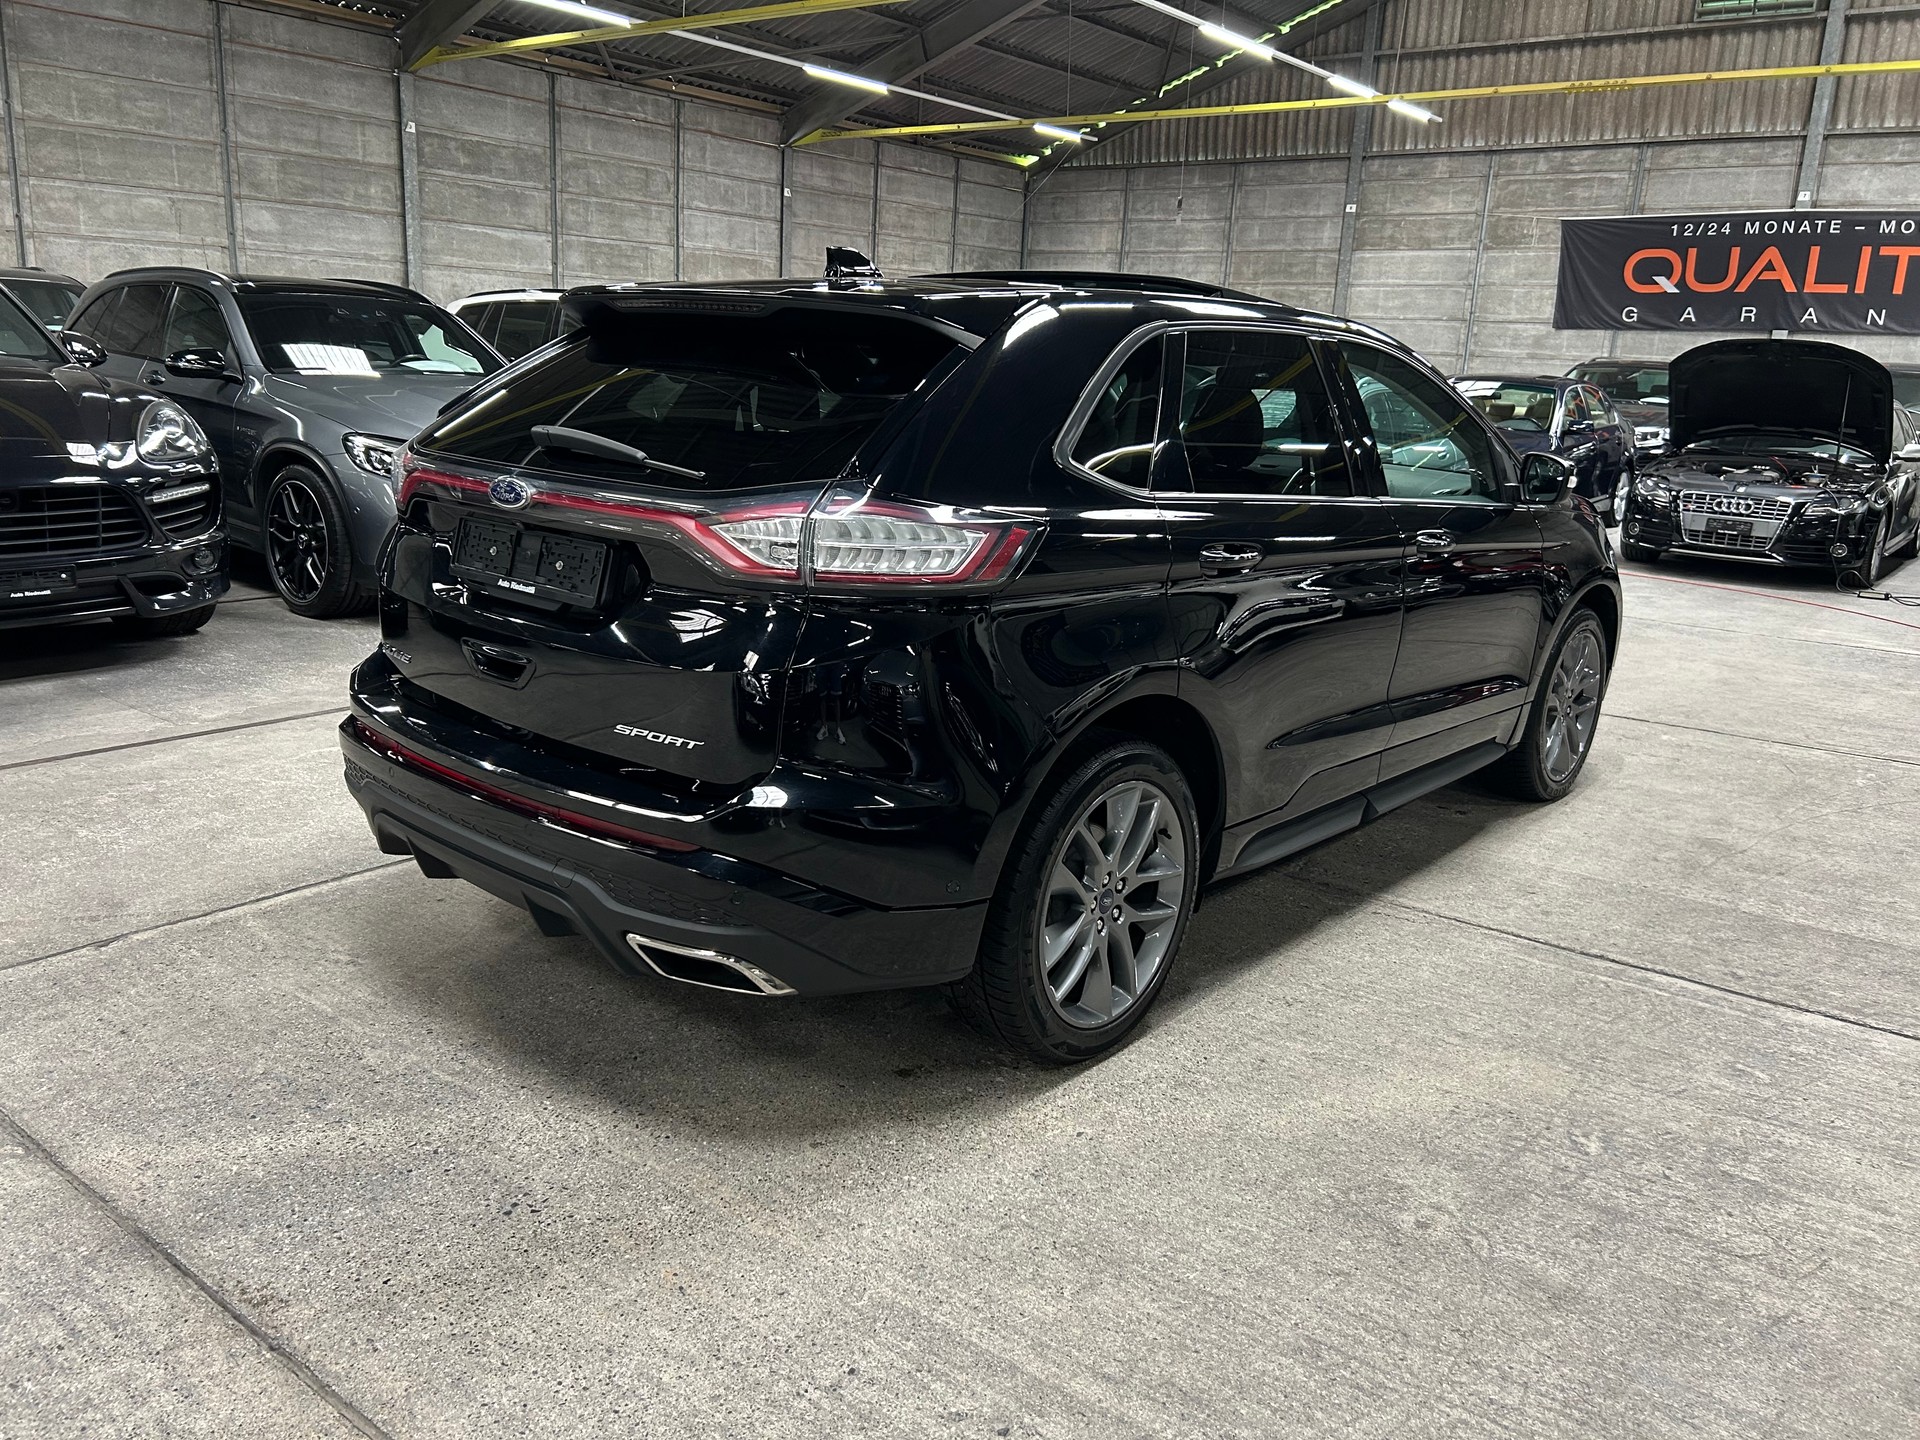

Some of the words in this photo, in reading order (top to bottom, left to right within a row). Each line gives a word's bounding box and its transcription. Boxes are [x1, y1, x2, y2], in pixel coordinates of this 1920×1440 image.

[1670, 222, 1732, 237] 12/24
[1744, 219, 1842, 235] MONATE
[1623, 245, 1920, 295] QUALIT
[497, 579, 511, 588] Auto
[613, 724, 705, 749] SPORT
